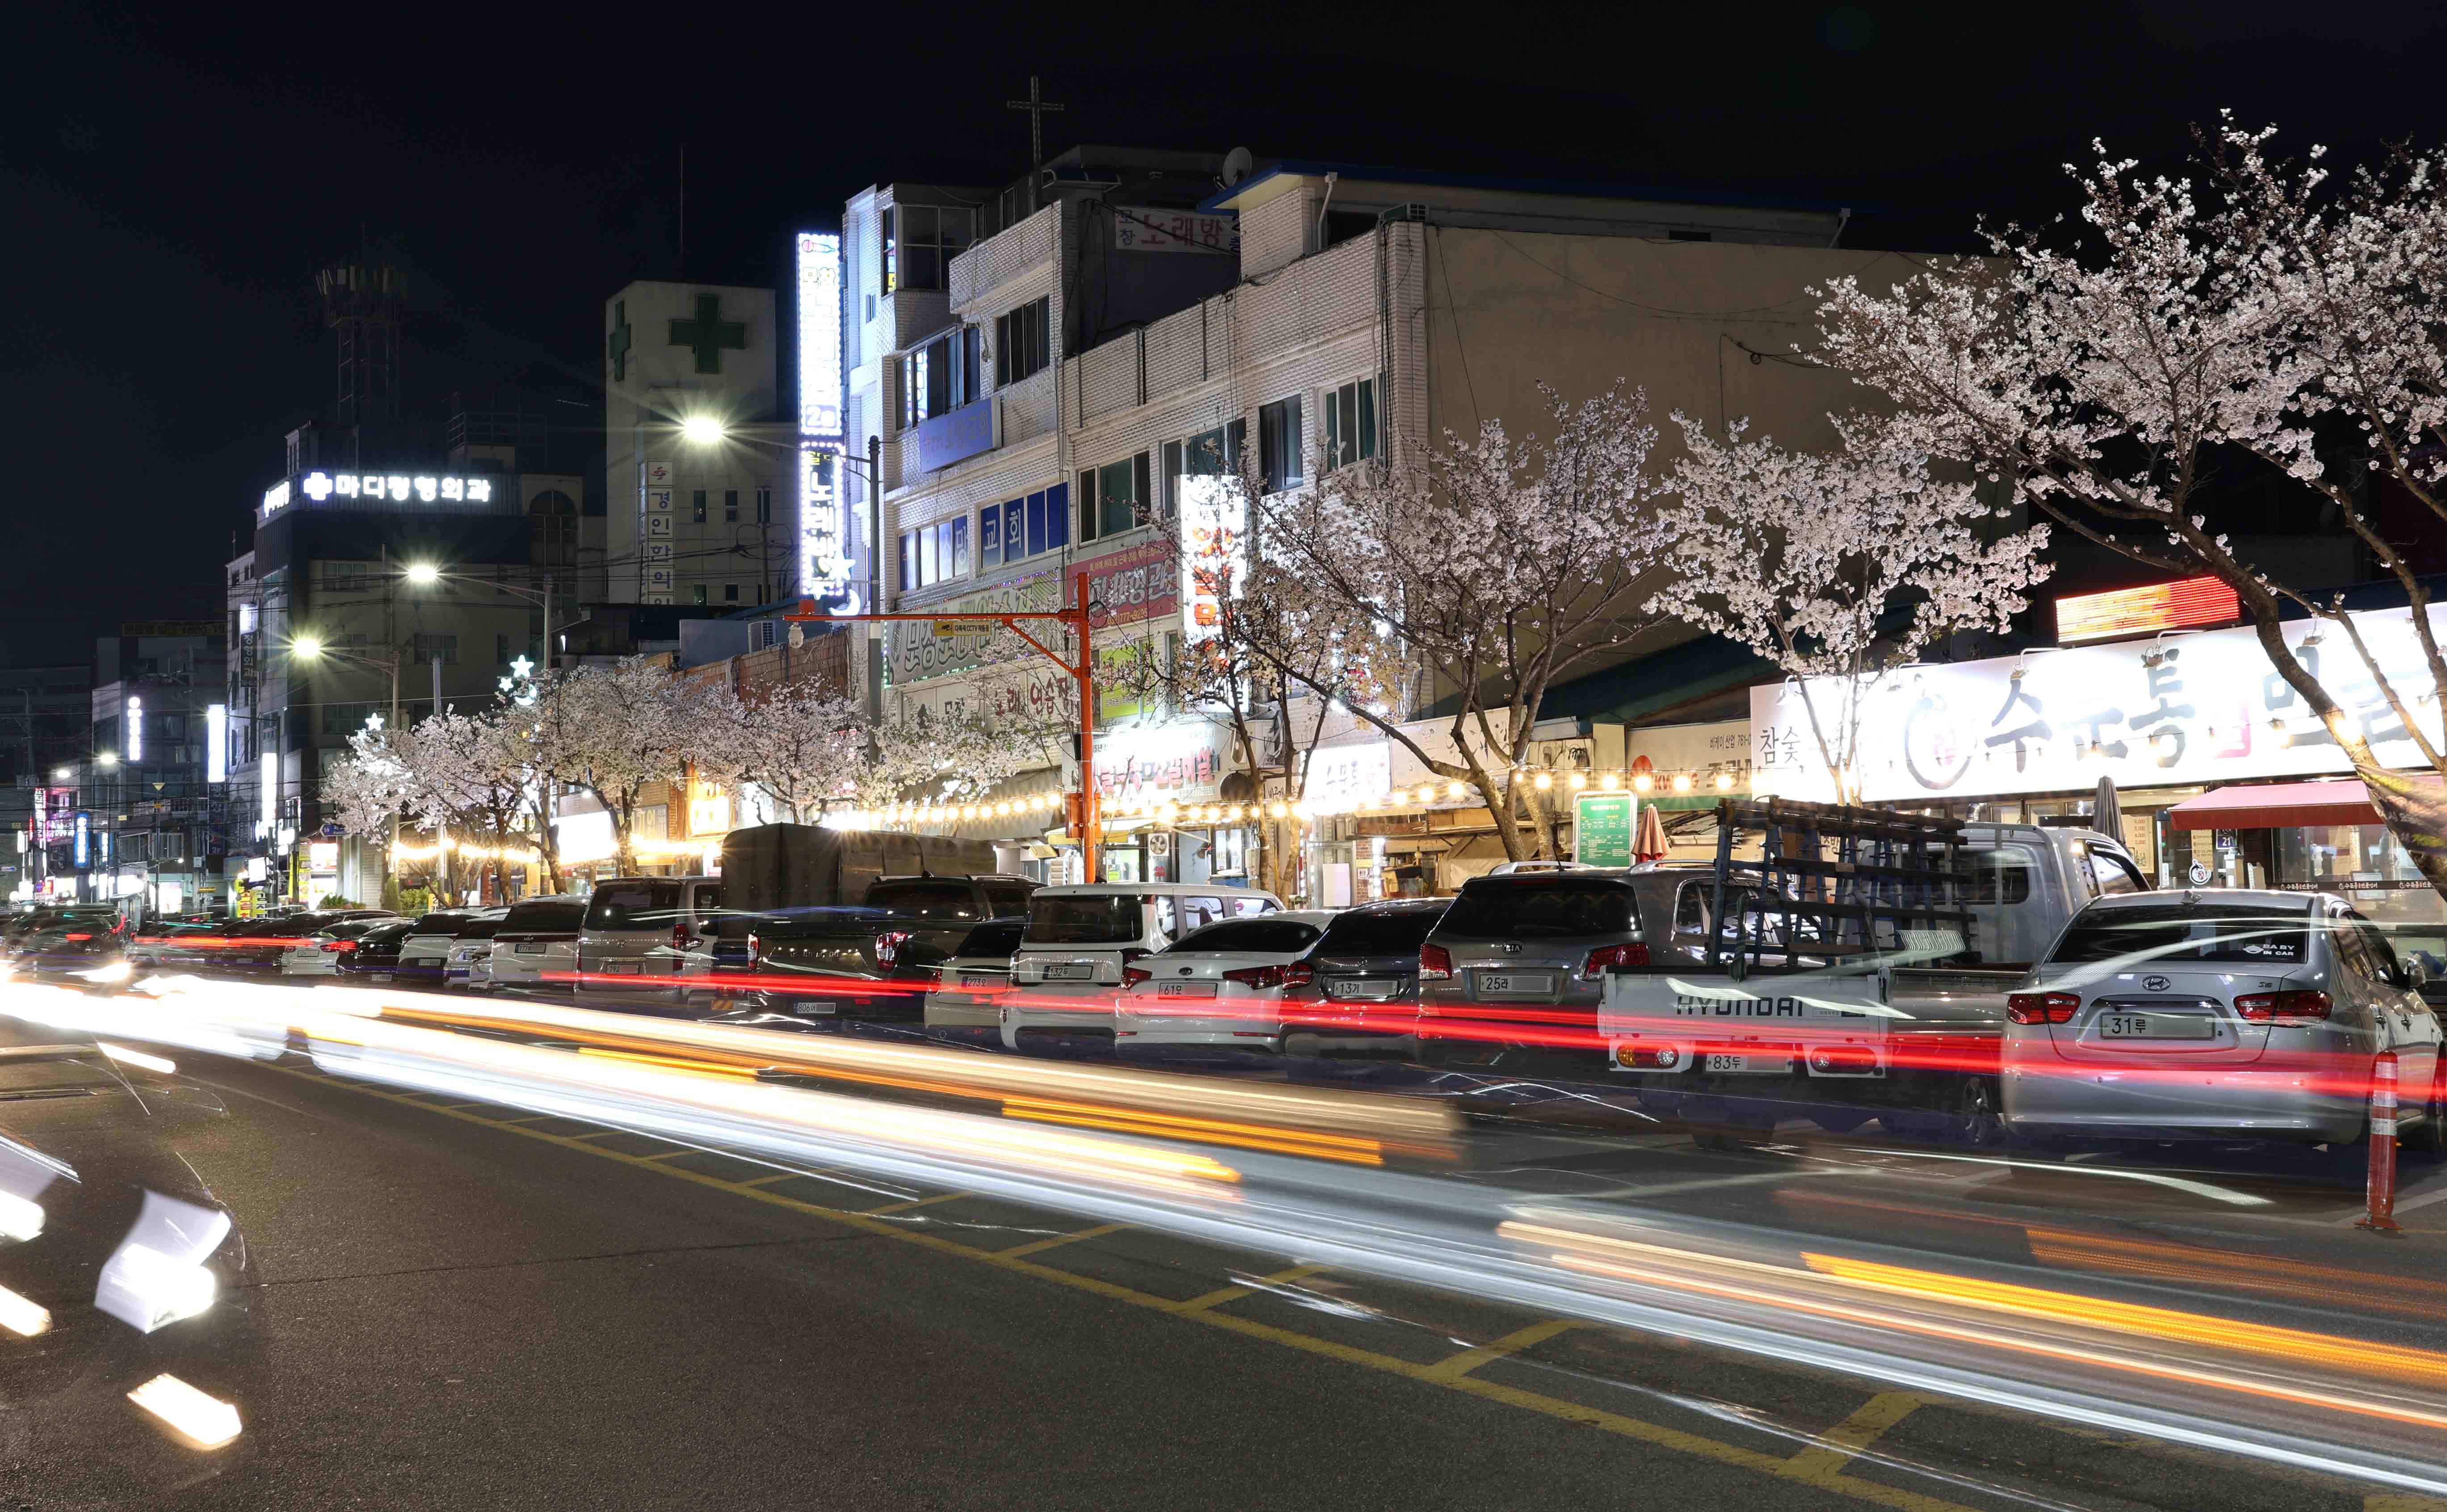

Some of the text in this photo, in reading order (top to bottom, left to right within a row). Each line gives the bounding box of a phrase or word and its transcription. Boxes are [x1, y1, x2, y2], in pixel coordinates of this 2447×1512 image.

[1141, 214, 1224, 247] 노래방
[985, 508, 1022, 550] 교회
[1760, 726, 1801, 765] 참숯
[2222, 837, 2230, 846] 21
[1486, 977, 1509, 990] 25라
[1677, 996, 1802, 1016] HYUNDAI
[2111, 1018, 2146, 1034] 31루
[1713, 1055, 1741, 1069] 83두
